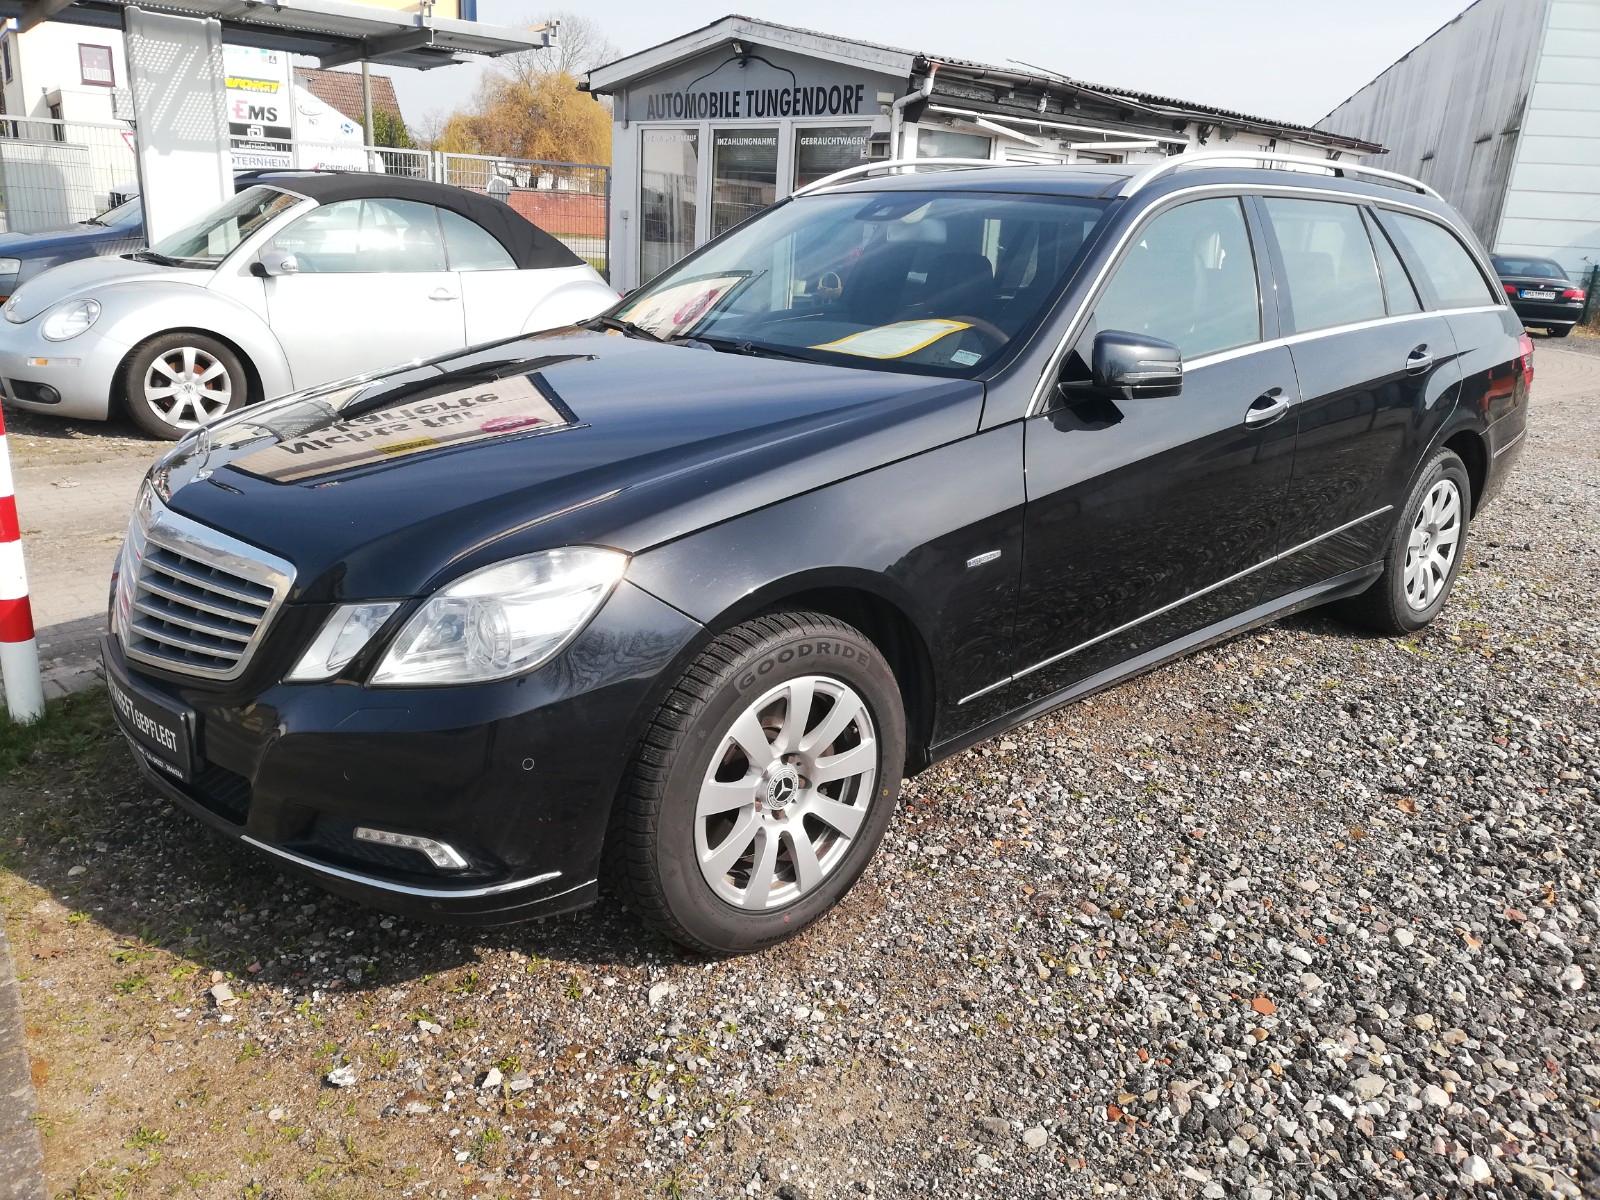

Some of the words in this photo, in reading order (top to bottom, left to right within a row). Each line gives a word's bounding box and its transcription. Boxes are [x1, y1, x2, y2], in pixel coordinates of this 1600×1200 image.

[232, 99, 278, 122] EMS
[646, 91, 740, 119] AUTOMOBILE
[746, 84, 865, 117] TUNGENDORF
[717, 136, 777, 146] INZAHLUNGNAHME
[800, 136, 866, 146] GEBRAUCHTWAGEN
[739, 641, 869, 690] GOODRIDE
[134, 708, 177, 753] GEPFLEGT
